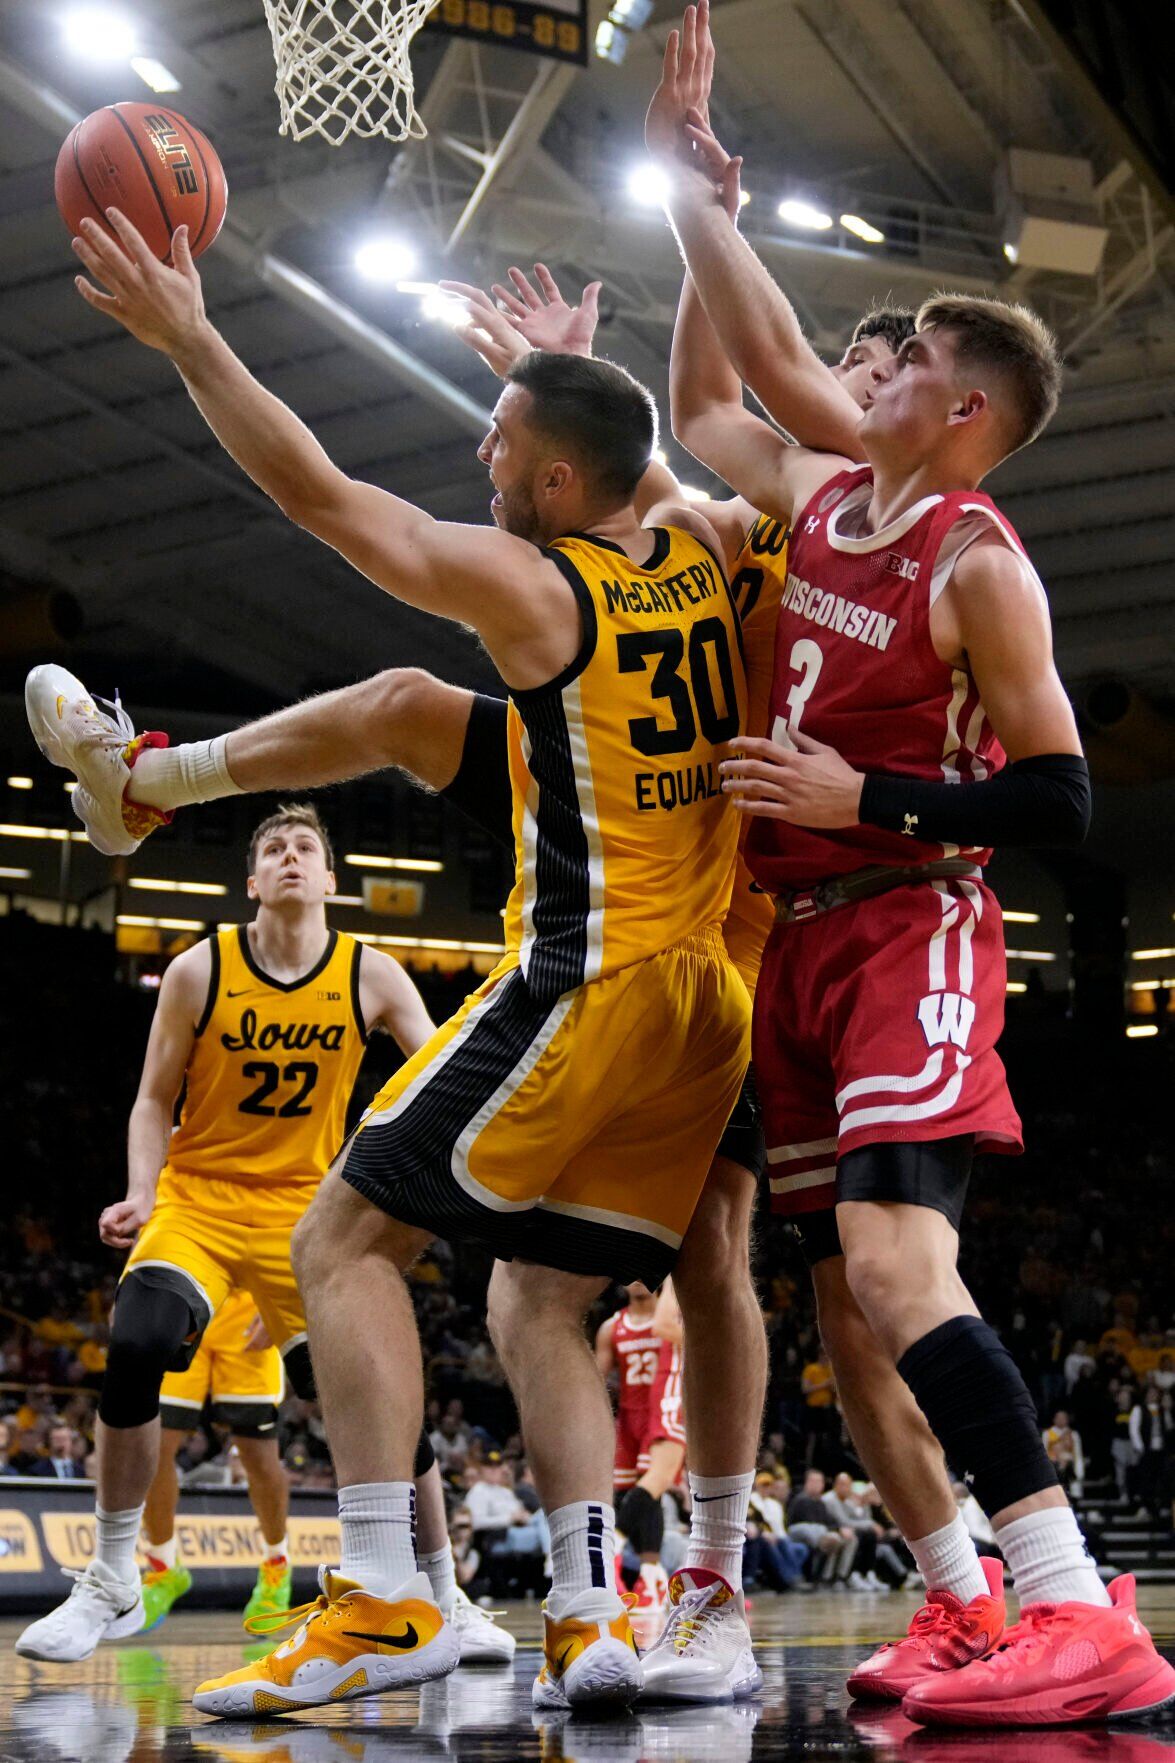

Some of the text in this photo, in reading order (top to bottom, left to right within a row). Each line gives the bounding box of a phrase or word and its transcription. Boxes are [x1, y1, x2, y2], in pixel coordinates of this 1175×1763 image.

[781, 572, 898, 652] WISCONSIN
[615, 615, 741, 757] 30
[771, 638, 824, 752] 3
[634, 752, 744, 811] EQUAL
[220, 1007, 346, 1052] Iowa
[237, 1060, 319, 1118] 22
[625, 1350, 659, 1386] 23
